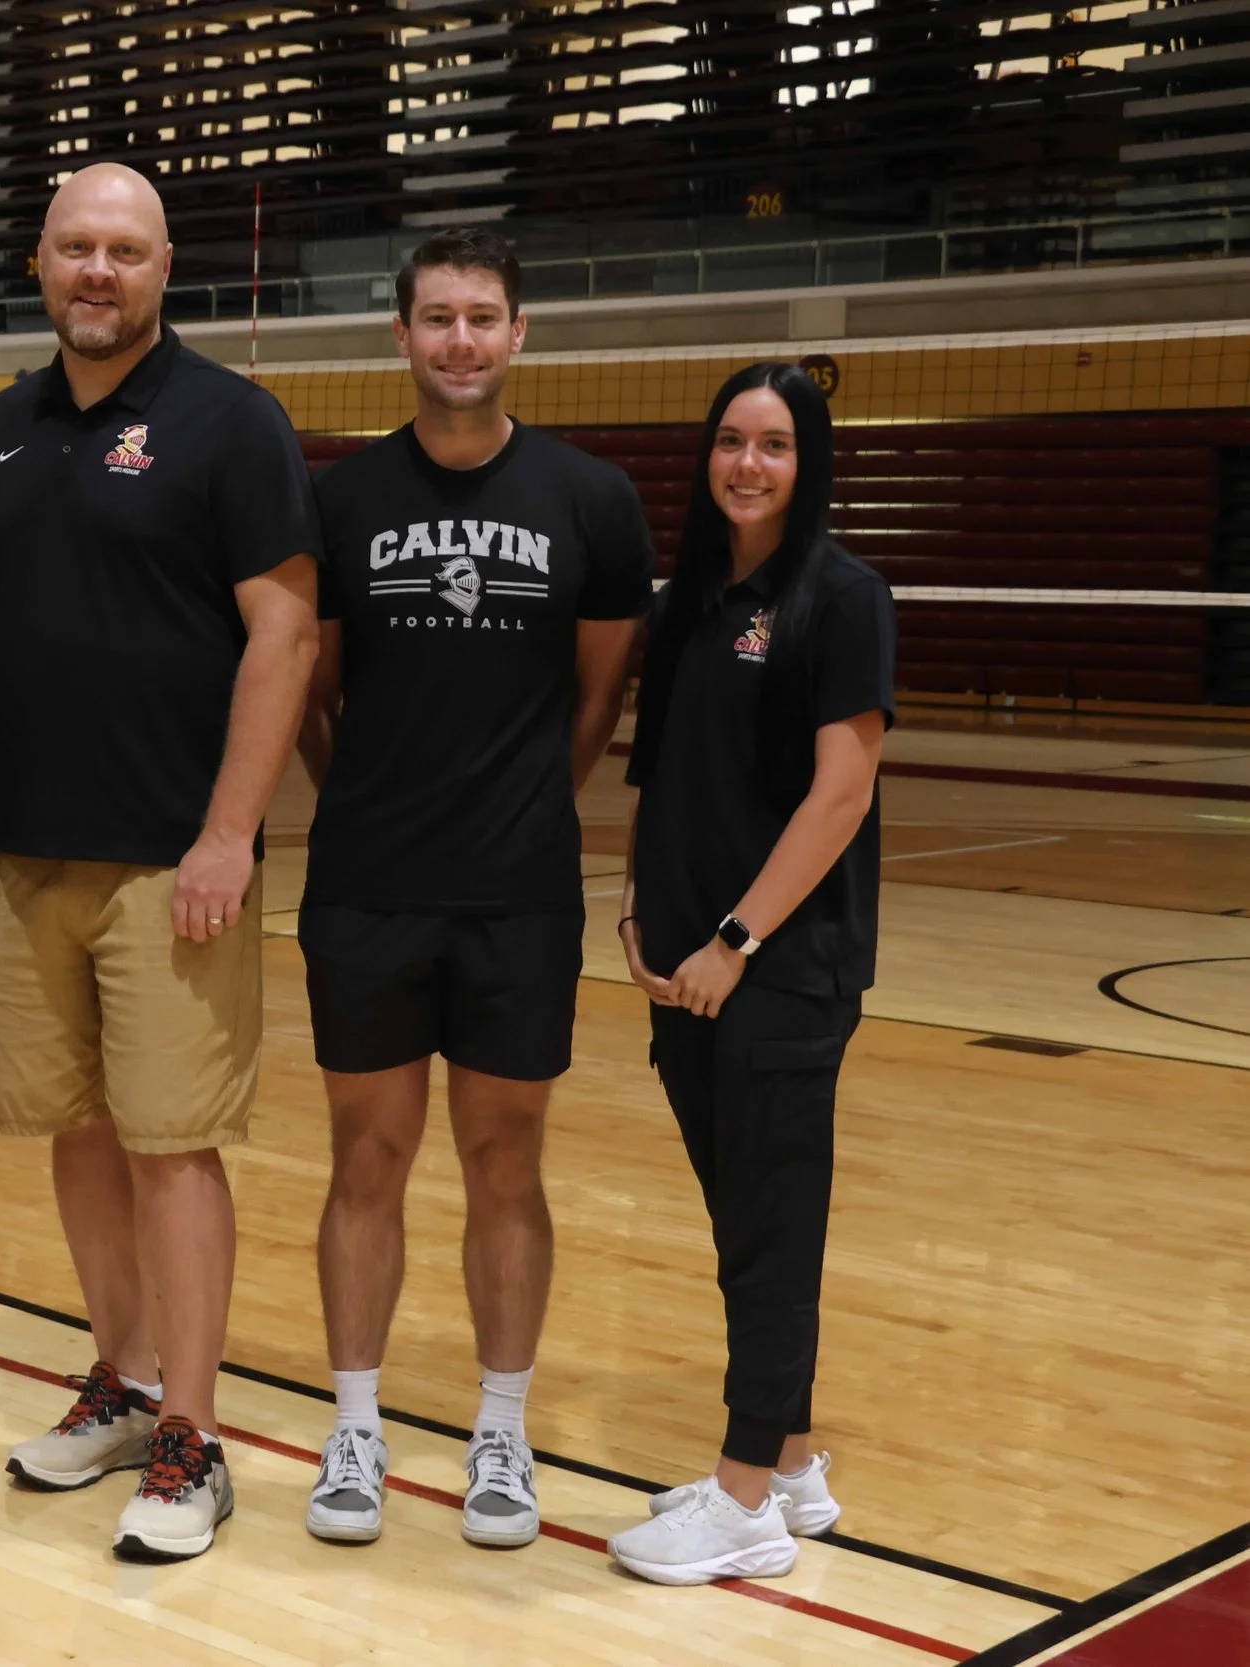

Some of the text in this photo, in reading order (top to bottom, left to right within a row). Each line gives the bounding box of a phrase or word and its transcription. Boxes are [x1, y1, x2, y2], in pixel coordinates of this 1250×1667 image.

[746, 192, 782, 218] 206
[807, 366, 833, 390] 05
[104, 451, 154, 469] CALVIN
[370, 520, 550, 575] CALVIN
[390, 616, 524, 630] FOOTBALL
[734, 636, 768, 655] CALV
